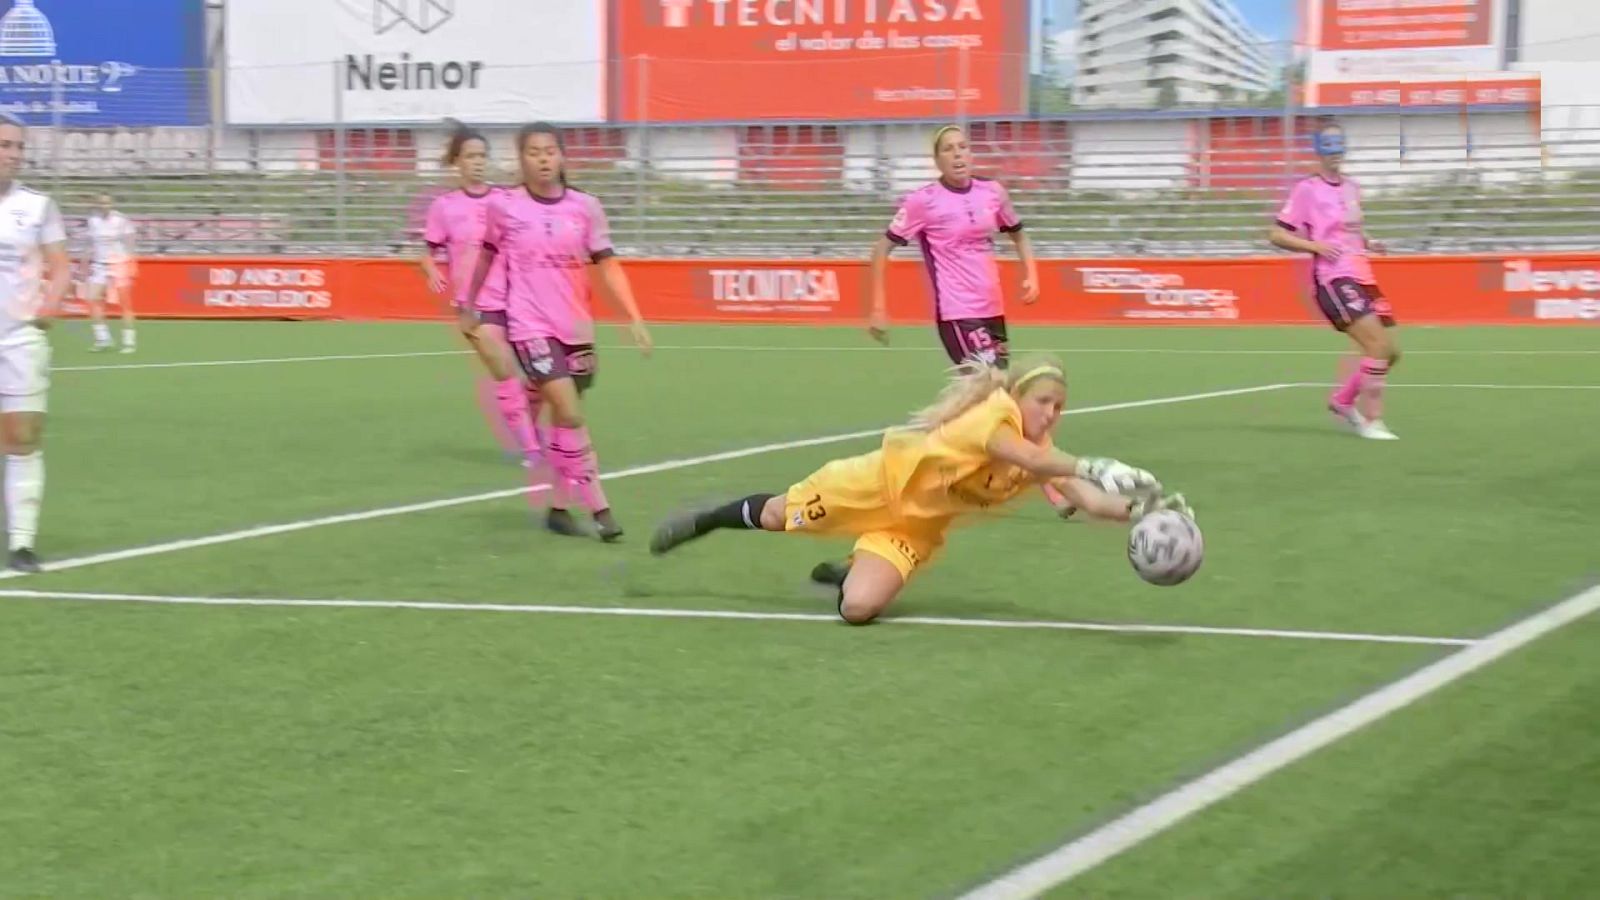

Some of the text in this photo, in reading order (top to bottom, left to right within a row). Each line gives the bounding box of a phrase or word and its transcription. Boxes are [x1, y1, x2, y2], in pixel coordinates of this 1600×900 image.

[346, 52, 483, 91] Neinor
[708, 269, 841, 301] TECNITASA
[968, 327, 992, 349] 15
[803, 494, 827, 521] 13
